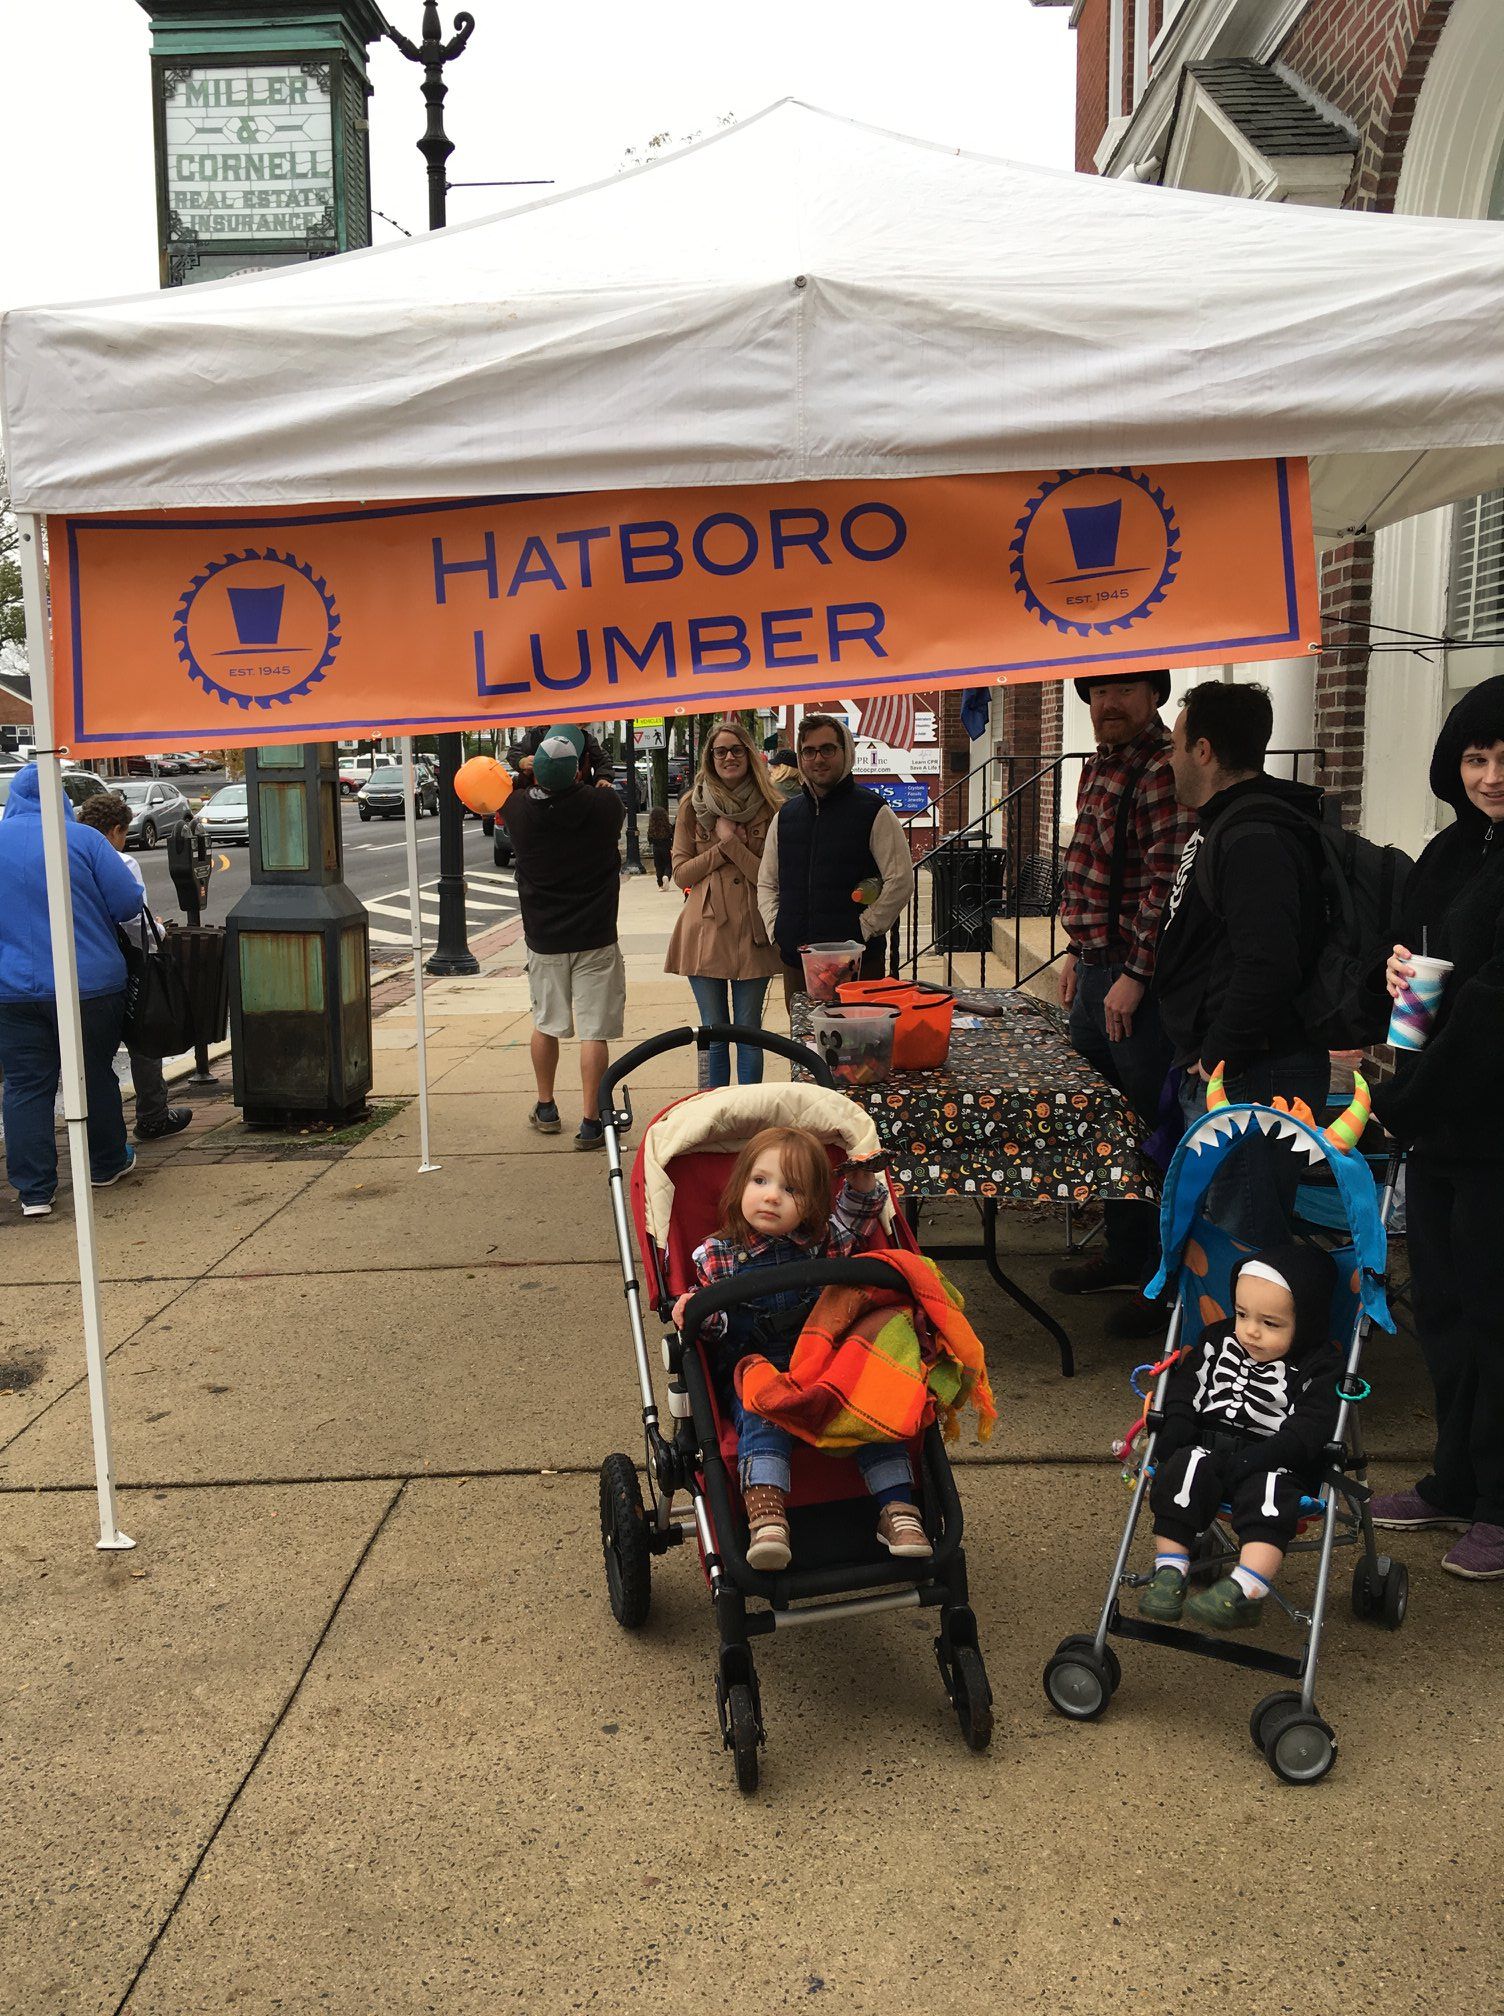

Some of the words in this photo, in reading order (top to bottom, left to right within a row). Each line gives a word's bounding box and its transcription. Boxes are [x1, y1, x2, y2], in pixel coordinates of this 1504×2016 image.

[185, 77, 307, 107] MILLER
[236, 115, 258, 144] &
[176, 151, 331, 181] CORNELL
[174, 191, 235, 209] REAL
[243, 188, 330, 208] ESTATE
[190, 213, 316, 232] INSURANCE
[433, 502, 906, 603] HATBORO
[1066, 594, 1093, 605] EST.
[1096, 588, 1129, 602] 1945
[474, 602, 887, 695] LUMBER
[229, 668, 255, 677] EST.
[258, 665, 291, 676] 1945
